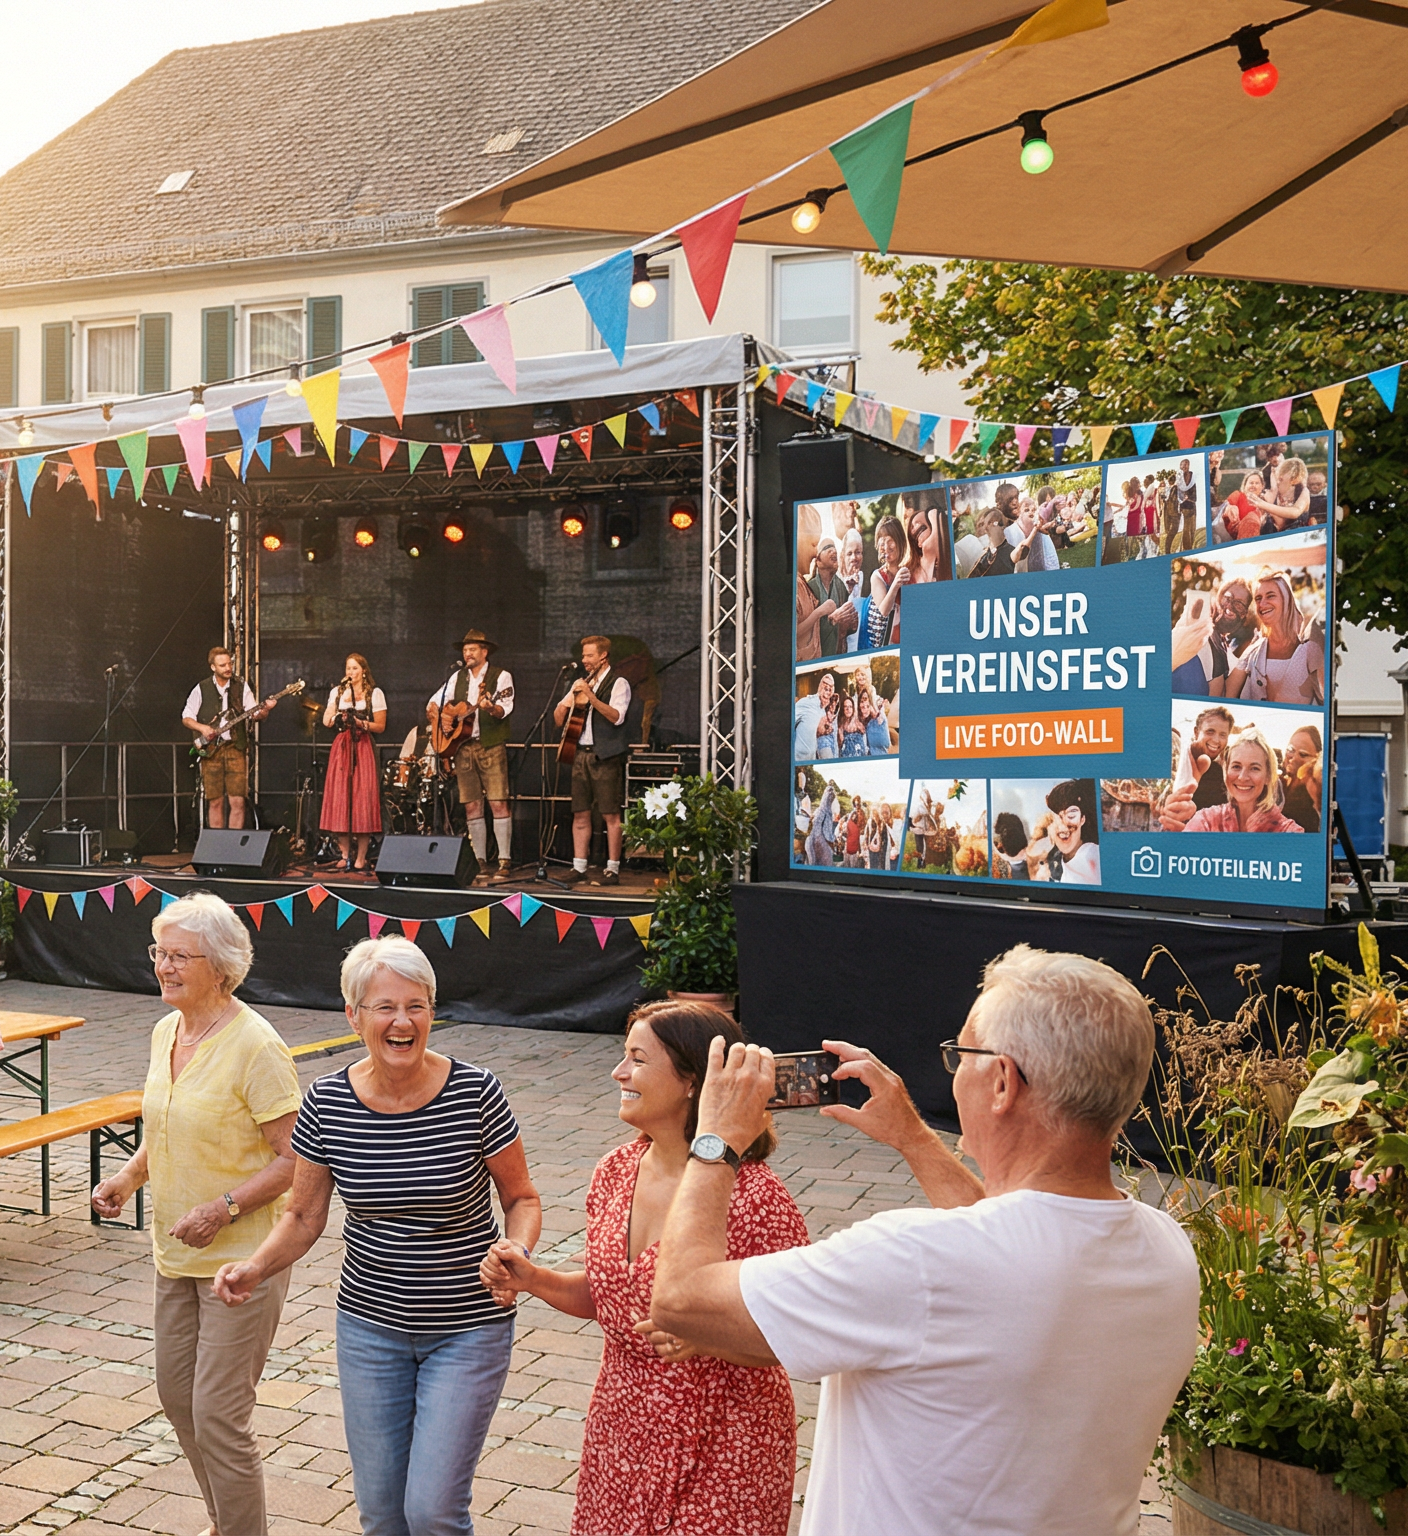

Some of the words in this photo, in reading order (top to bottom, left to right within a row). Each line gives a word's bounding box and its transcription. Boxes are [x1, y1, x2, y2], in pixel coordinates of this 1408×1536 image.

[969, 592, 1089, 640] UNSER
[911, 645, 1156, 694] VEREINSFEST
[944, 725, 986, 749] LIVE
[992, 719, 1114, 747] FOTO-WALL
[1168, 855, 1303, 882] FOTOTEILEN.DE
